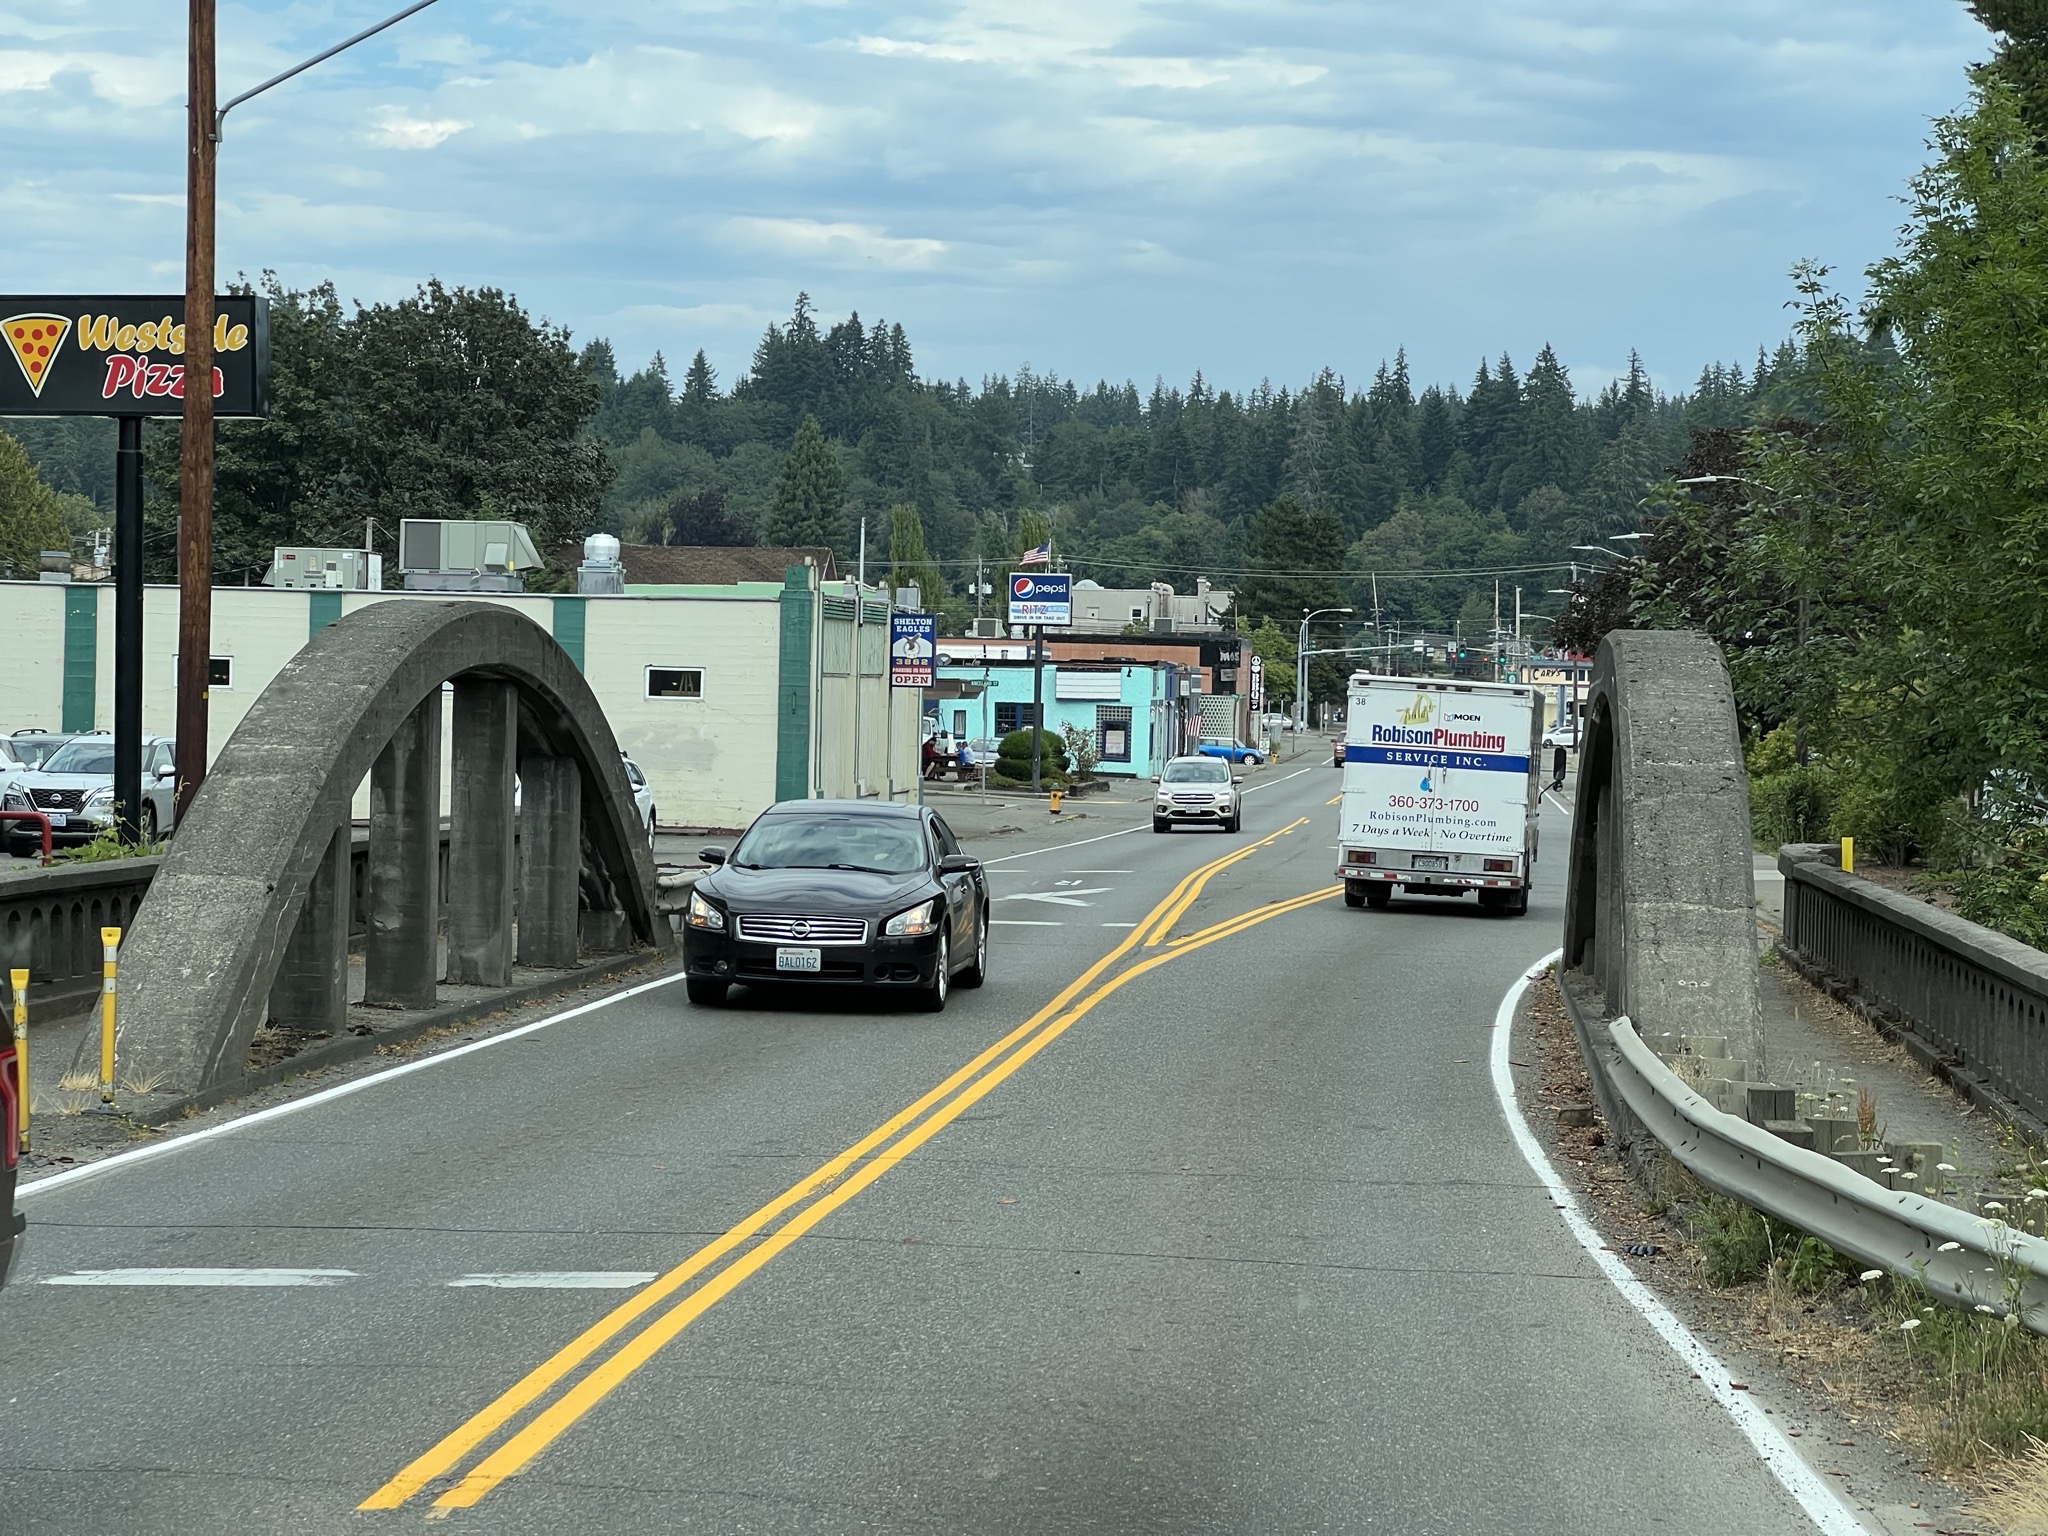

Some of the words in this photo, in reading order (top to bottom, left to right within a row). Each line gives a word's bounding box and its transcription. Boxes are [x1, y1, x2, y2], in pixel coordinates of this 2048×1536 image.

[77, 313, 249, 354] Westsde
[1035, 583, 1066, 595] pepsi
[1021, 604, 1047, 615] RITZ
[894, 618, 933, 626] SHELTON
[896, 625, 931, 633] EAGLES
[895, 675, 929, 684] OPEN
[1355, 697, 1366, 706] 38
[1453, 713, 1481, 722] MOEN
[1371, 724, 1506, 753] RobisonPlumbing
[1386, 751, 1448, 764] SERVICE
[1455, 756, 1487, 767] INC.
[1388, 794, 1479, 812] 360-373-1700
[1369, 810, 1497, 828] RobisonPlumbing.com
[1352, 823, 1360, 833] 7
[1361, 824, 1390, 837] Days
[1392, 828, 1400, 836] a
[1402, 826, 1430, 838] Week
[1440, 829, 1457, 839] No
[1458, 830, 1512, 843] Overtime
